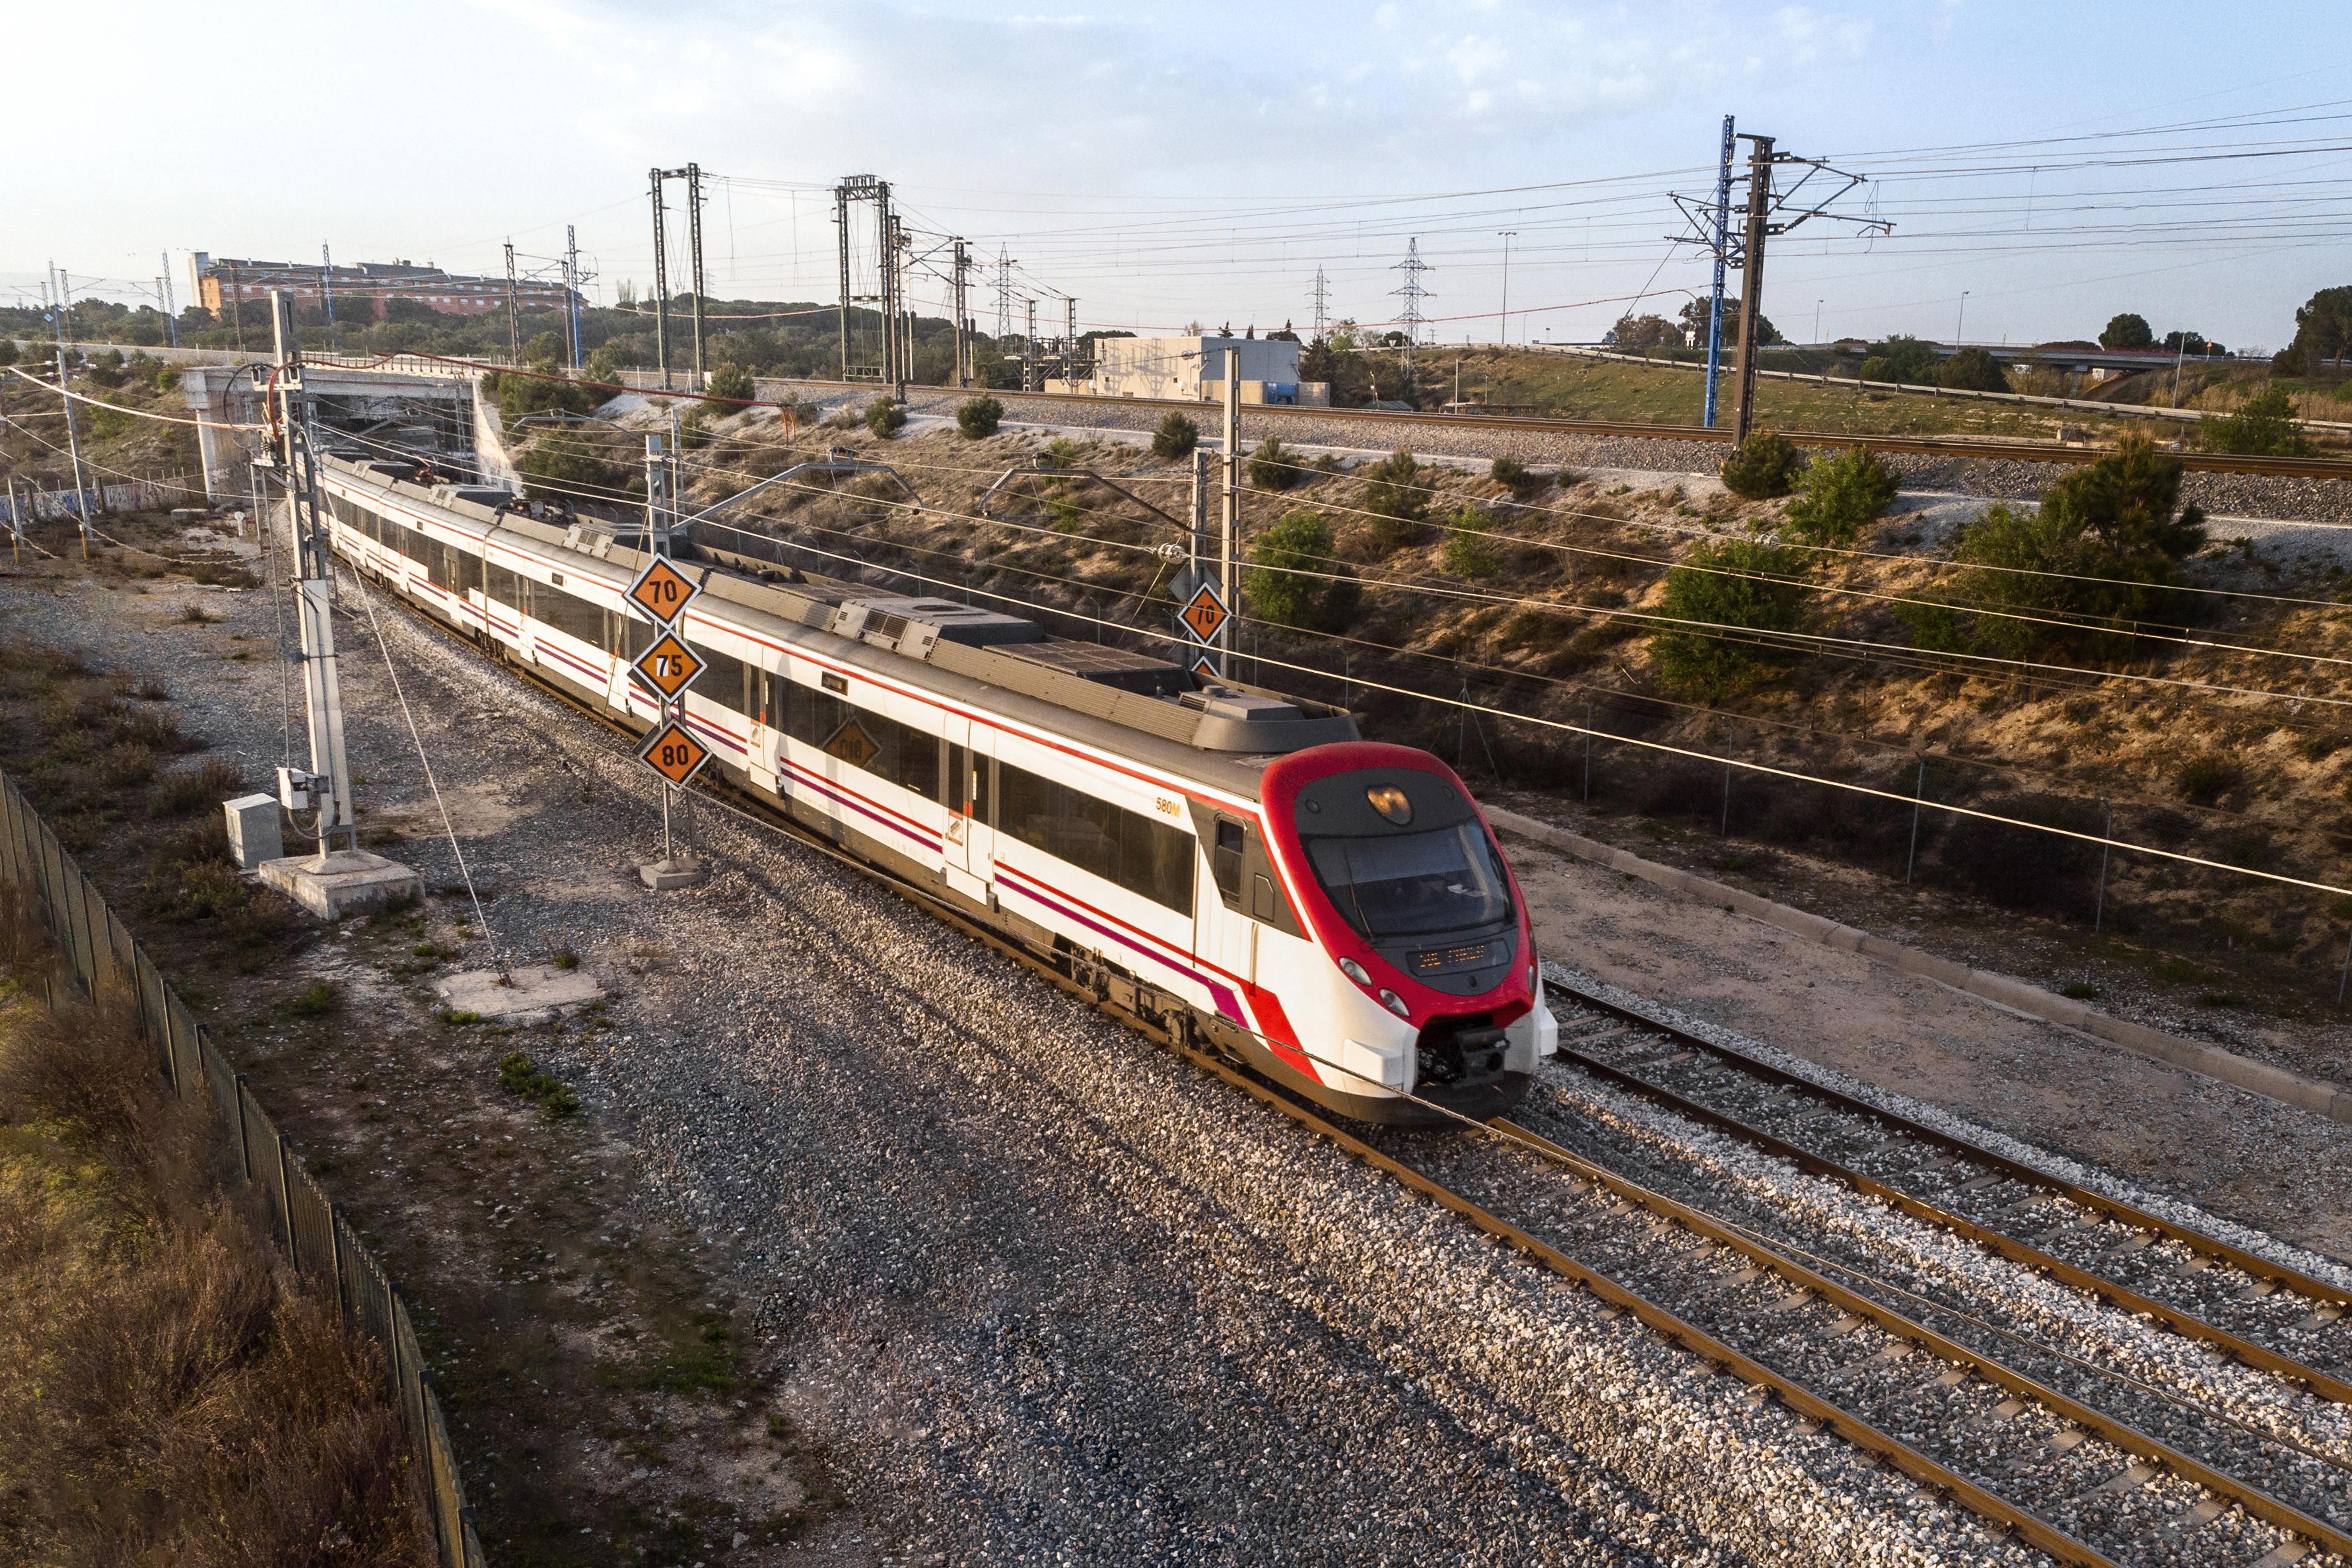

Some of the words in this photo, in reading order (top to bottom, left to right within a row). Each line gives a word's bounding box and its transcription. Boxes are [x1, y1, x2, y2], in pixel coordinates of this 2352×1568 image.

[649, 580, 677, 603] 70
[1196, 605, 1214, 625] 70
[657, 655, 683, 677] 75
[662, 744, 688, 767] 80
